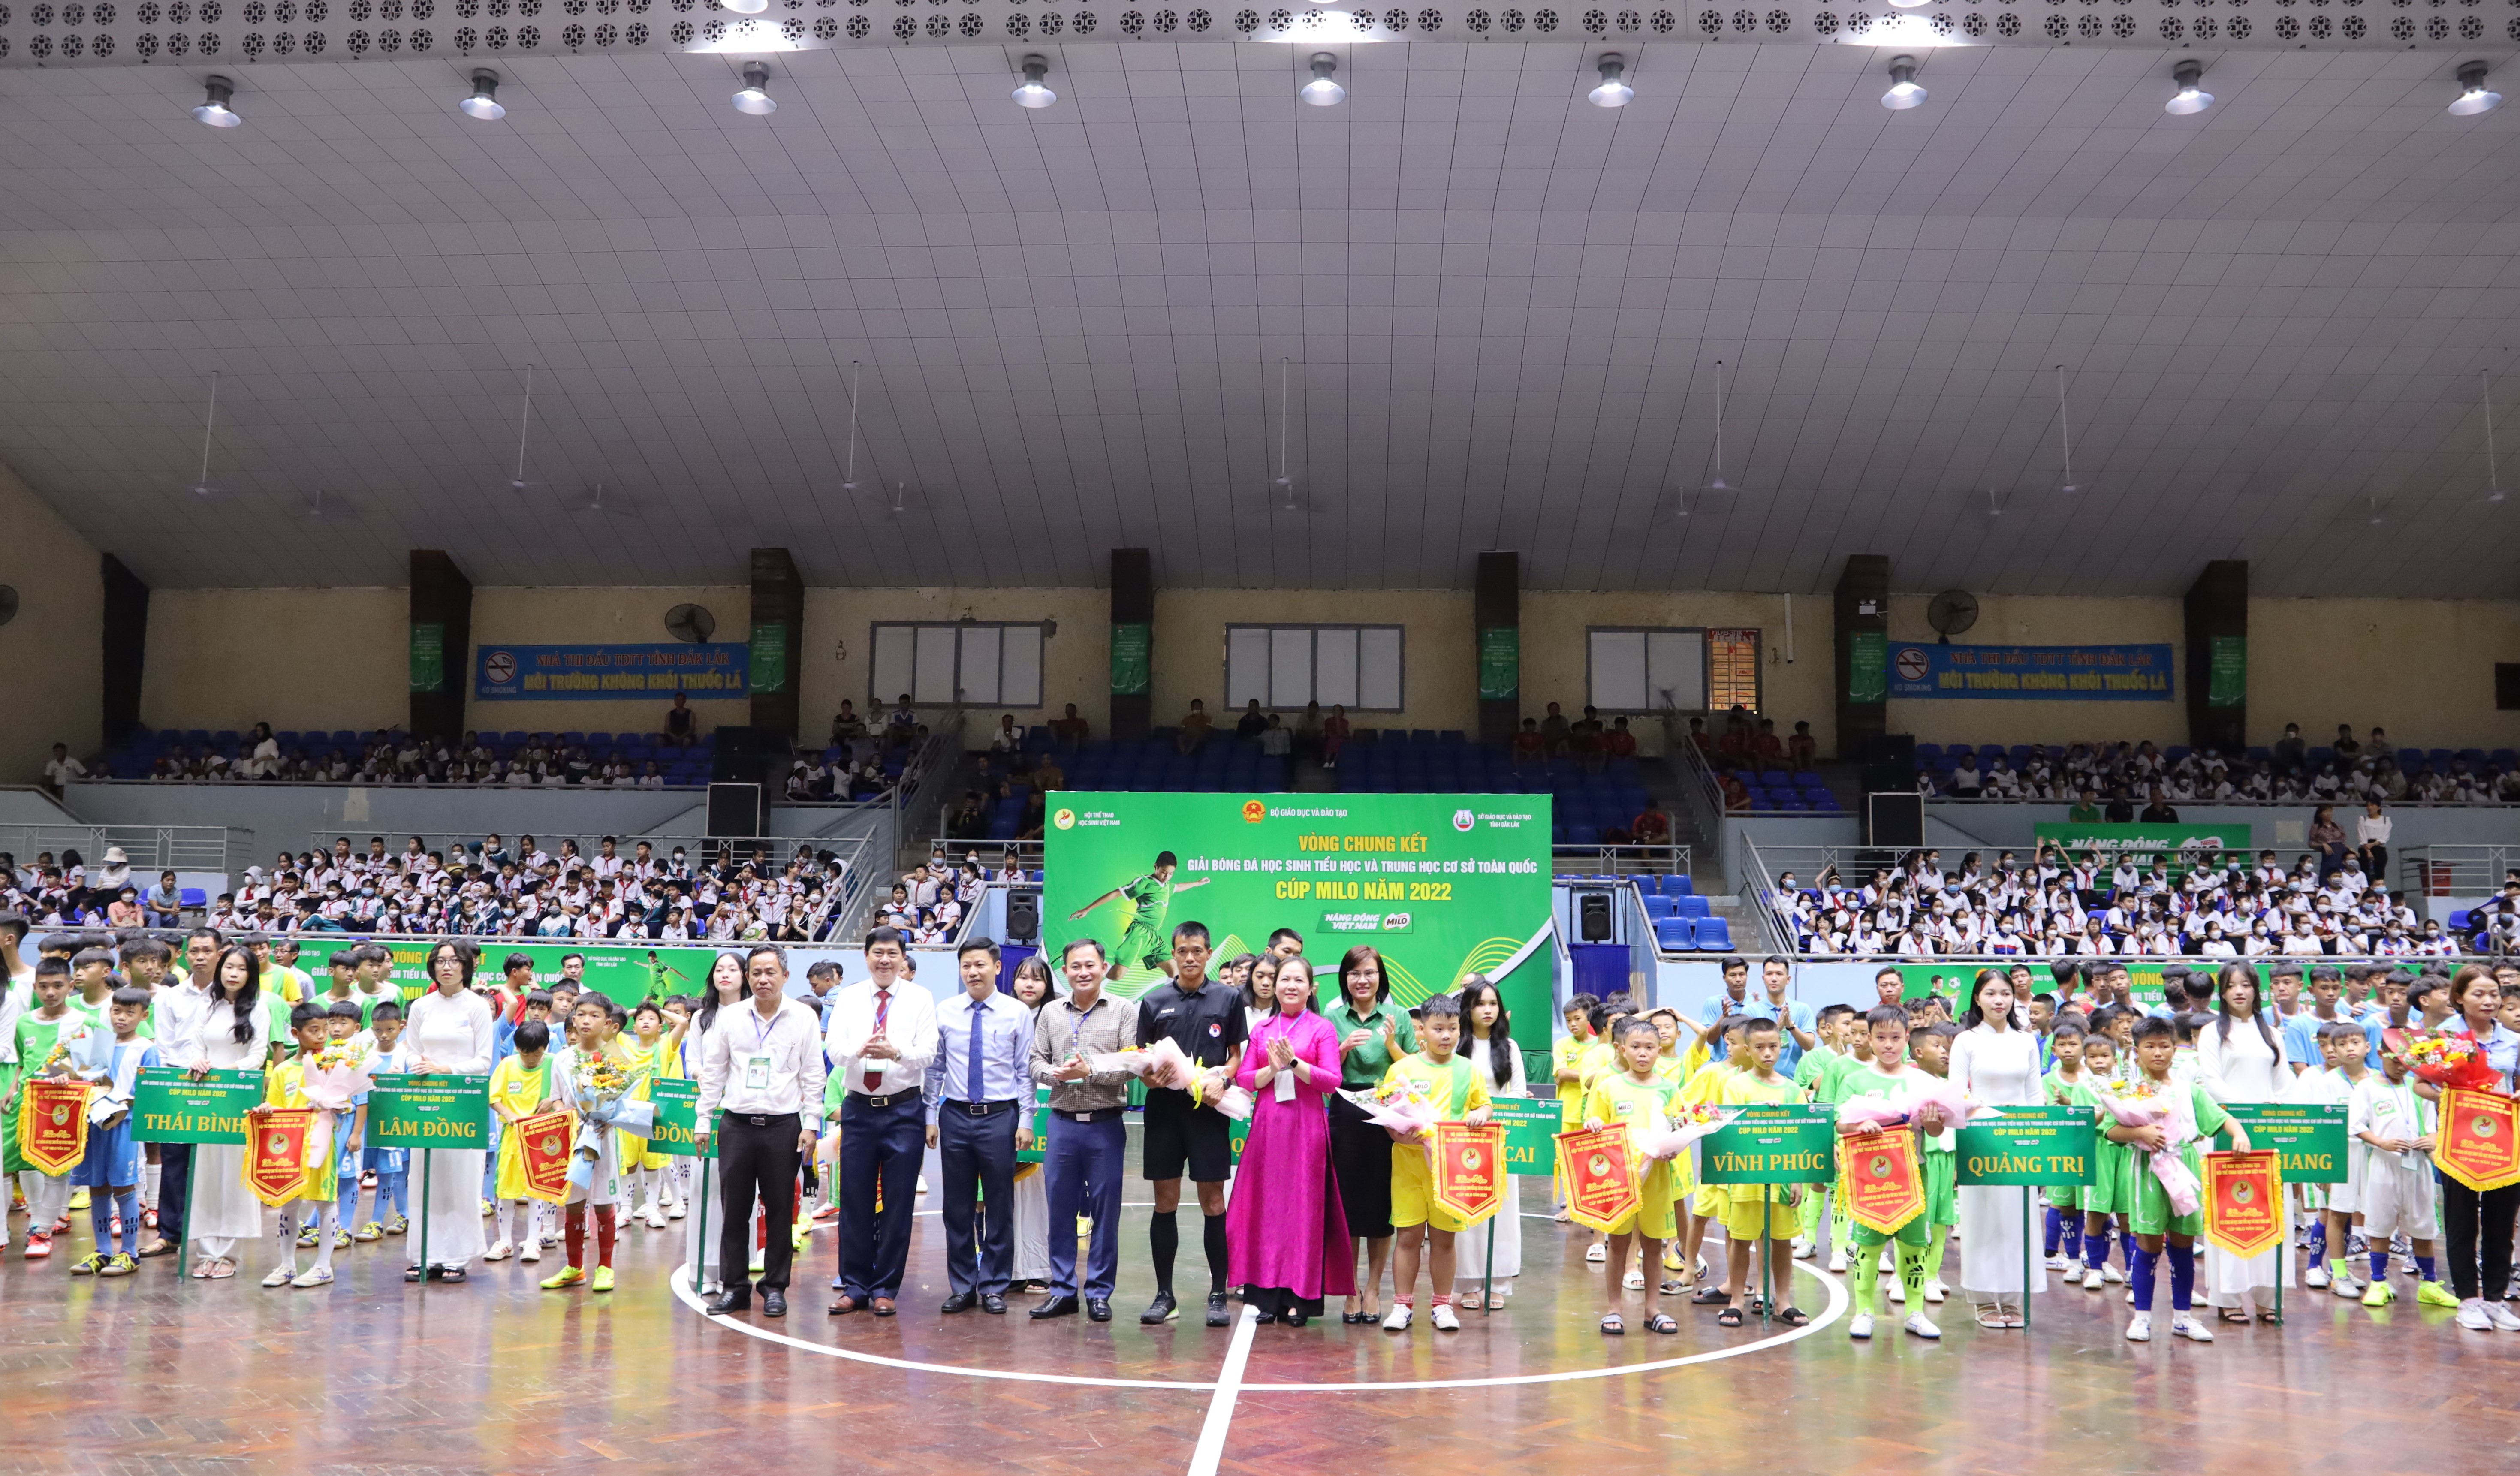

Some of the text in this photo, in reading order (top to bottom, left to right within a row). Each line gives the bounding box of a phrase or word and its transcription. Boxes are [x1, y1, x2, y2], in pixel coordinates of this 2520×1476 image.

[536, 651, 560, 666] NHÀ
[565, 654, 584, 666] THI
[587, 648, 611, 665] ĐẤU
[614, 654, 643, 665] TDTT
[1980, 653, 2000, 664] THI
[2033, 654, 2064, 665] TDTT
[726, 669, 742, 689] LÁ
[1270, 807, 1347, 818] BỘ GIÁO DỤC VÀ ĐÀO TẠO
[1299, 831, 1428, 852] VÒNG CHUNG KẾT
[2121, 836, 2168, 849] ĐỘNG
[1188, 855, 1537, 875] GIẢI BÓNG ĐÁ HỌC SINH TIỂU HỌC VÀ TRUNG HỌC CƠ SỞ TOÀN QUỐC
[1275, 877, 1452, 901] CÚP MILO NĂM 2022
[1324, 913, 1380, 922] NĂNG ĐỘNG
[1387, 917, 1407, 926] MILO
[1331, 922, 1354, 931] VIỆT
[393, 949, 422, 964] VÒNG
[311, 964, 327, 977] GIẢI
[403, 966, 564, 983] TIỂU HỌC QUỐC
[2131, 970, 2163, 986] VÒNG
[2144, 990, 2161, 1002] TIỂU
[144, 1111, 193, 1131] THÁI
[197, 1112, 246, 1133] BÌNH
[379, 1116, 476, 1137] LÂM ĐỒNG
[1738, 1126, 1751, 1134] CÚP
[2254, 1125, 2266, 1133] CÚP
[488, 1133, 497, 1146] 2
[654, 1121, 694, 1144] ĐỒN
[1993, 1127, 2007, 1136] CÚP
[388, 1151, 402, 1167] 11
[1504, 1145, 1535, 1163] CAI
[1712, 1149, 1824, 1172] VĨNH PHÚC
[2281, 1154, 2333, 1170] IANG
[127, 1160, 134, 1177] 3
[342, 1156, 351, 1172] 5
[1968, 1152, 2084, 1177] QUẢNG TRỊ
[608, 1179, 617, 1196] 8
[1665, 1211, 1676, 1230] 10
